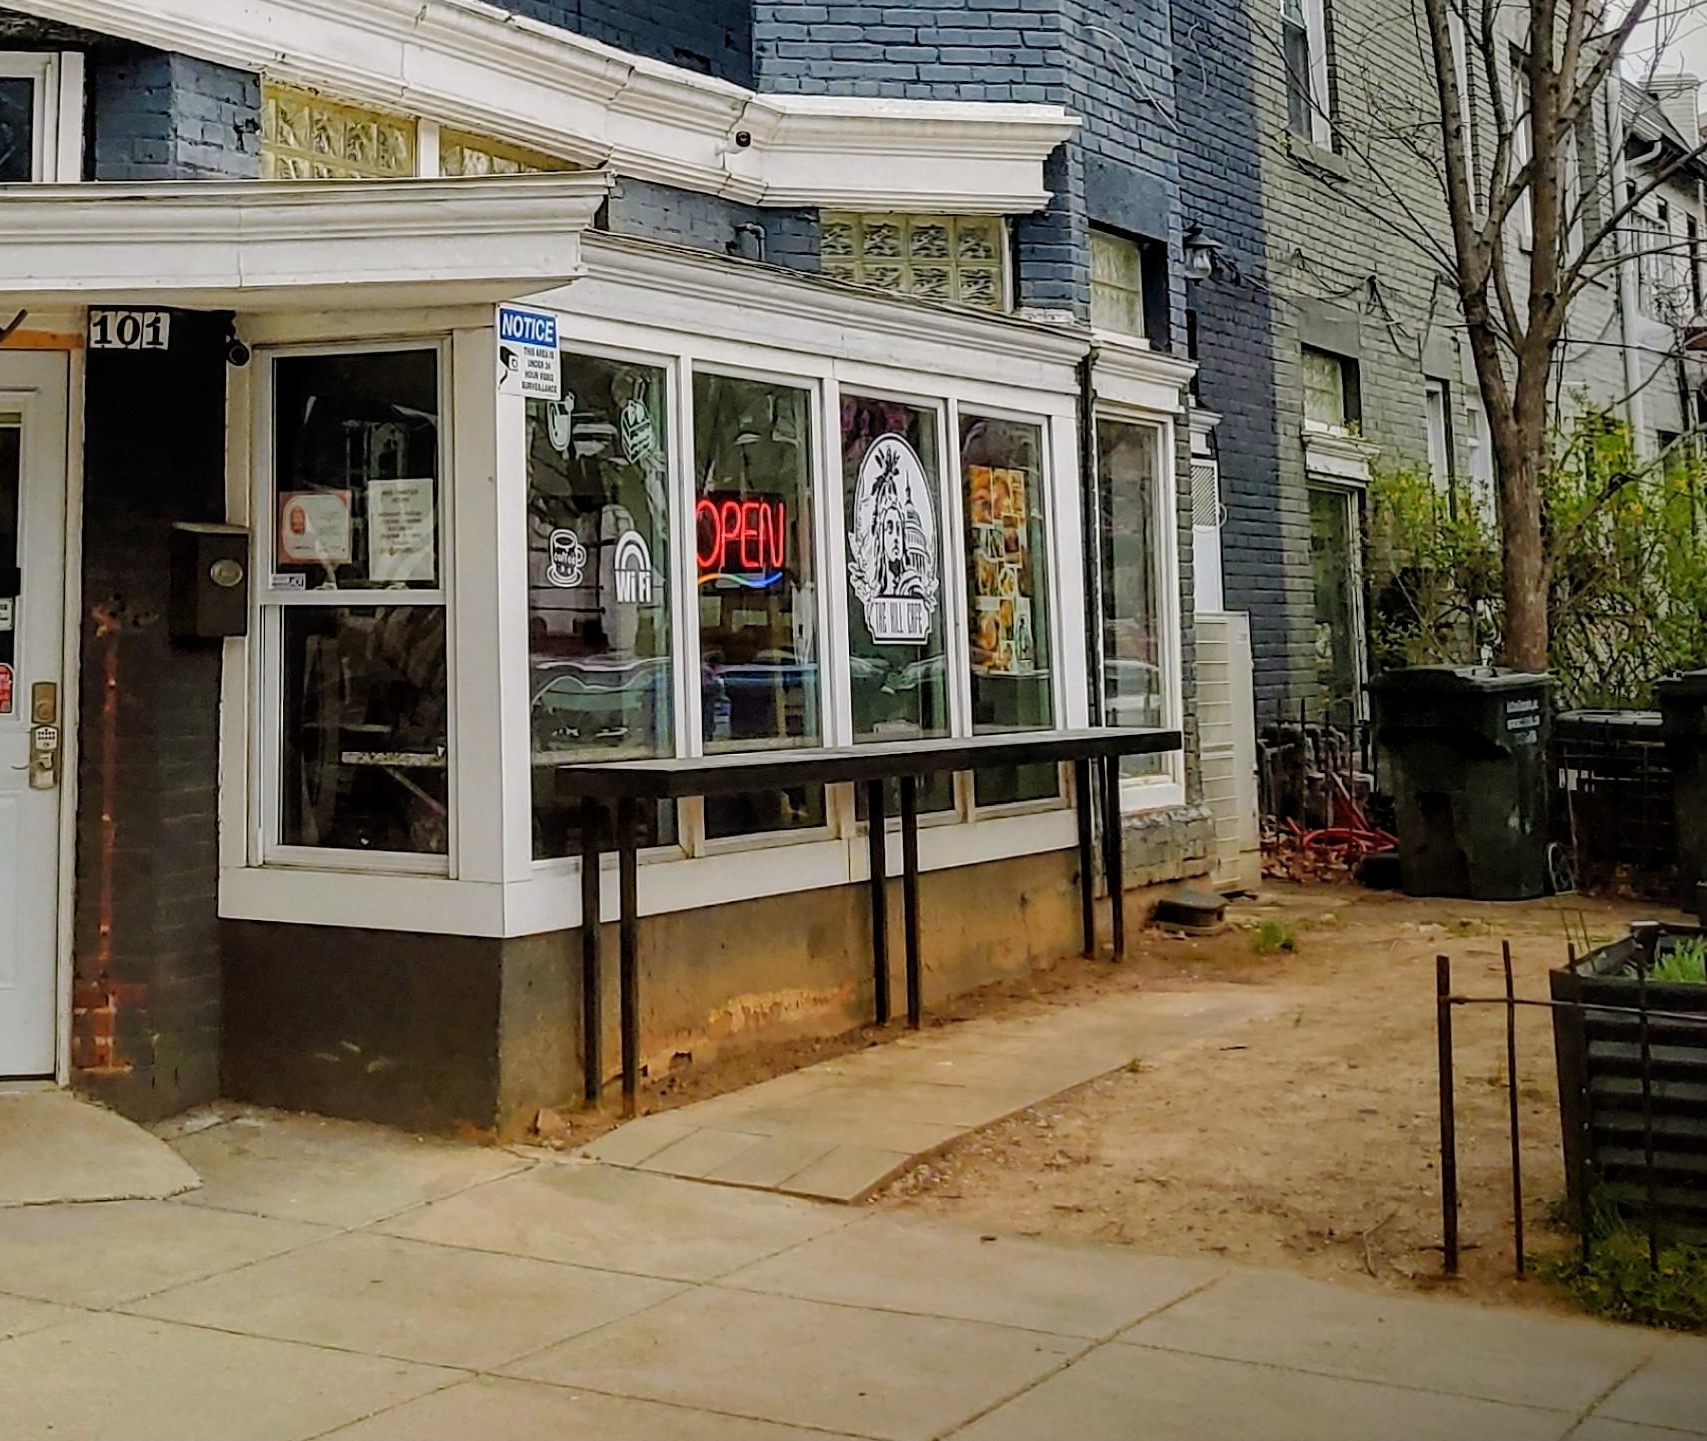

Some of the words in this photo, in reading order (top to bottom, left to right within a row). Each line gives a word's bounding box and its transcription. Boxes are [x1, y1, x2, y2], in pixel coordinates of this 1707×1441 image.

[92, 314, 164, 346] 101
[501, 312, 555, 343] NOTICE
[696, 499, 784, 568] OPEN
[873, 602, 887, 634] THE
[889, 602, 904, 634] HILL
[907, 602, 923, 634] CAFE
